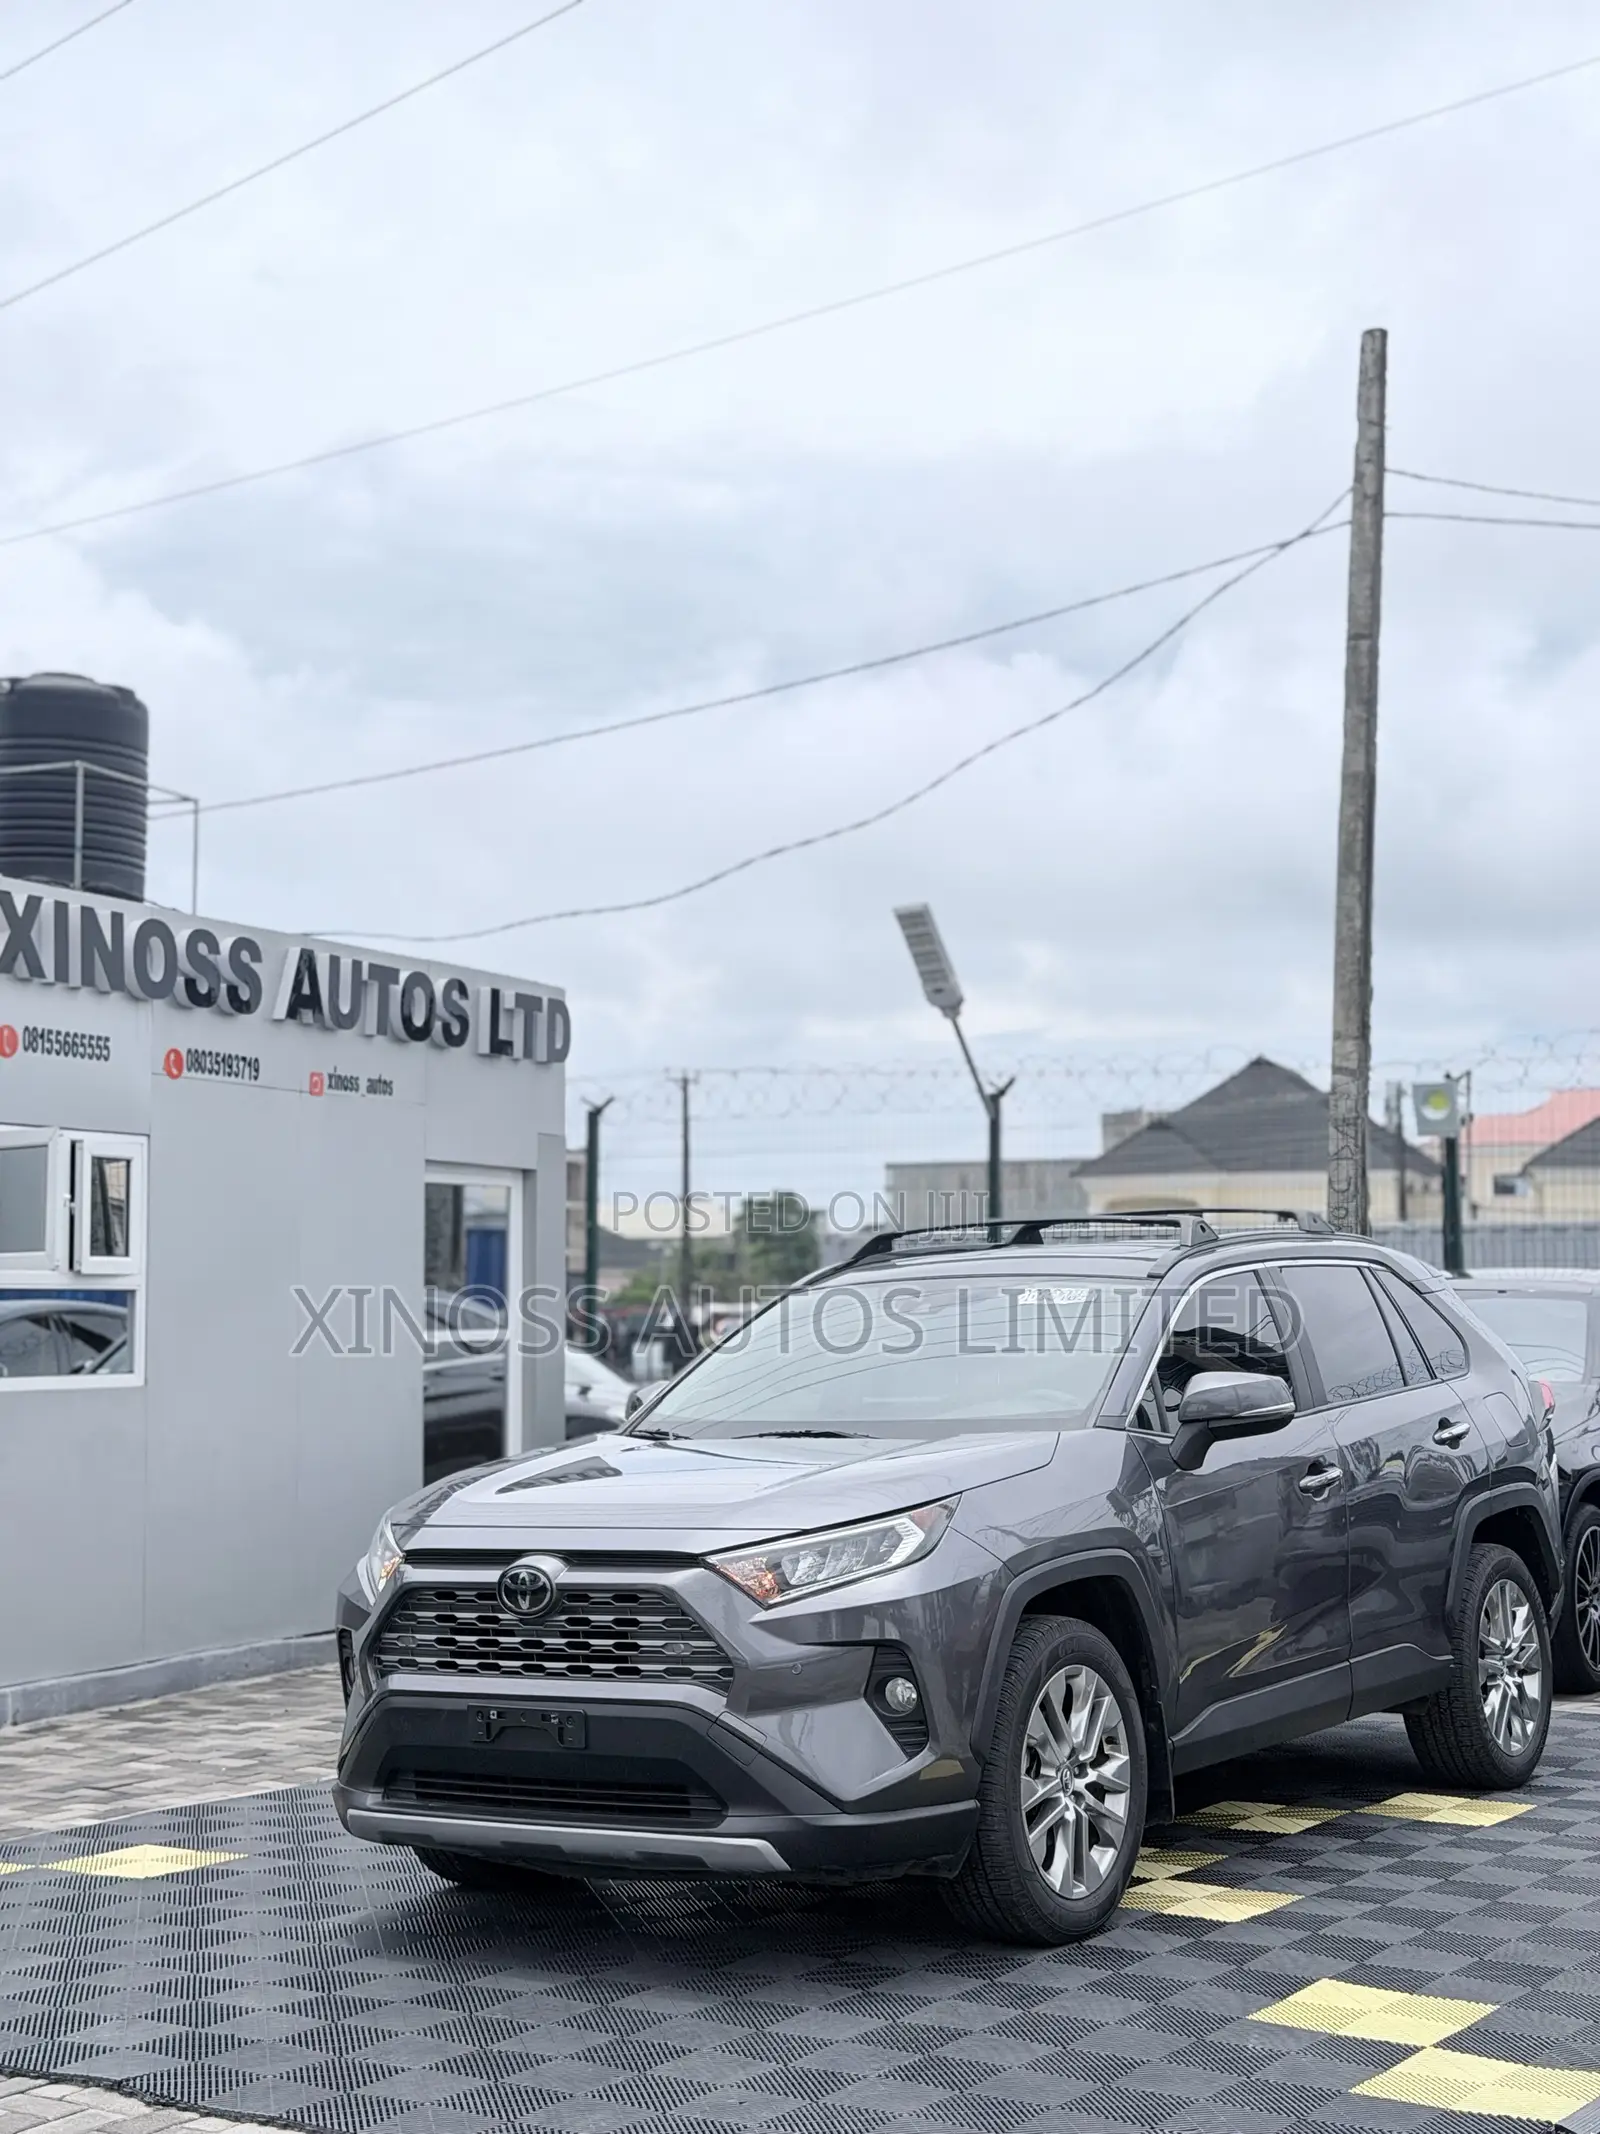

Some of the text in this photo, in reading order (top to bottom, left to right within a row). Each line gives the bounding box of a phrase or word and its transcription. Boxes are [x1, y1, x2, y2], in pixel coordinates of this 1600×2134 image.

[0, 889, 572, 1063] XINOSS AUTOS LTD
[22, 1025, 111, 1061] 08155665555
[186, 1048, 260, 1081] 08035193719
